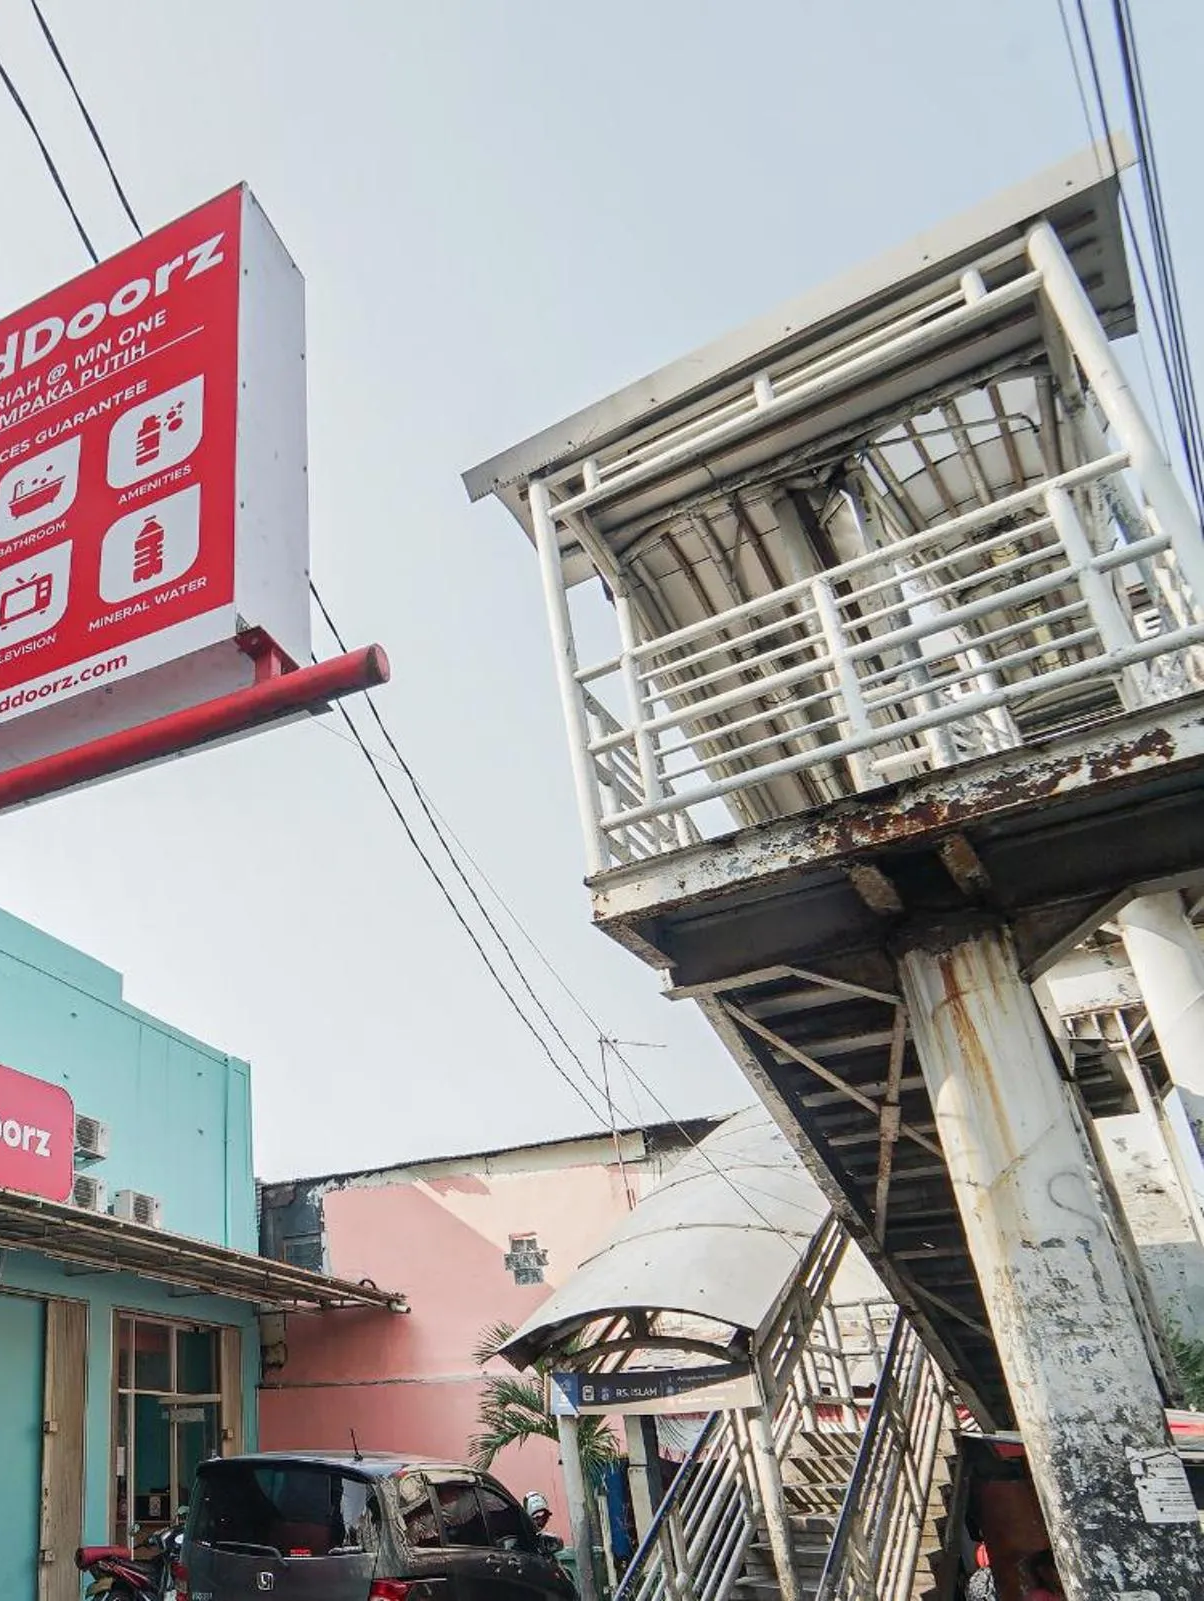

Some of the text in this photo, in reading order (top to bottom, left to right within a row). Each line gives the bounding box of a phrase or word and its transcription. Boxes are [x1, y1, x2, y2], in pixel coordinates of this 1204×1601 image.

[47, 364, 67, 383] @
[74, 341, 112, 370] MN
[118, 309, 168, 345] ONE
[79, 341, 147, 390] PUTIH
[35, 379, 148, 446] GUARANTEE
[118, 465, 192, 505] AMENITIES
[88, 576, 208, 632] MINERAL WATER
